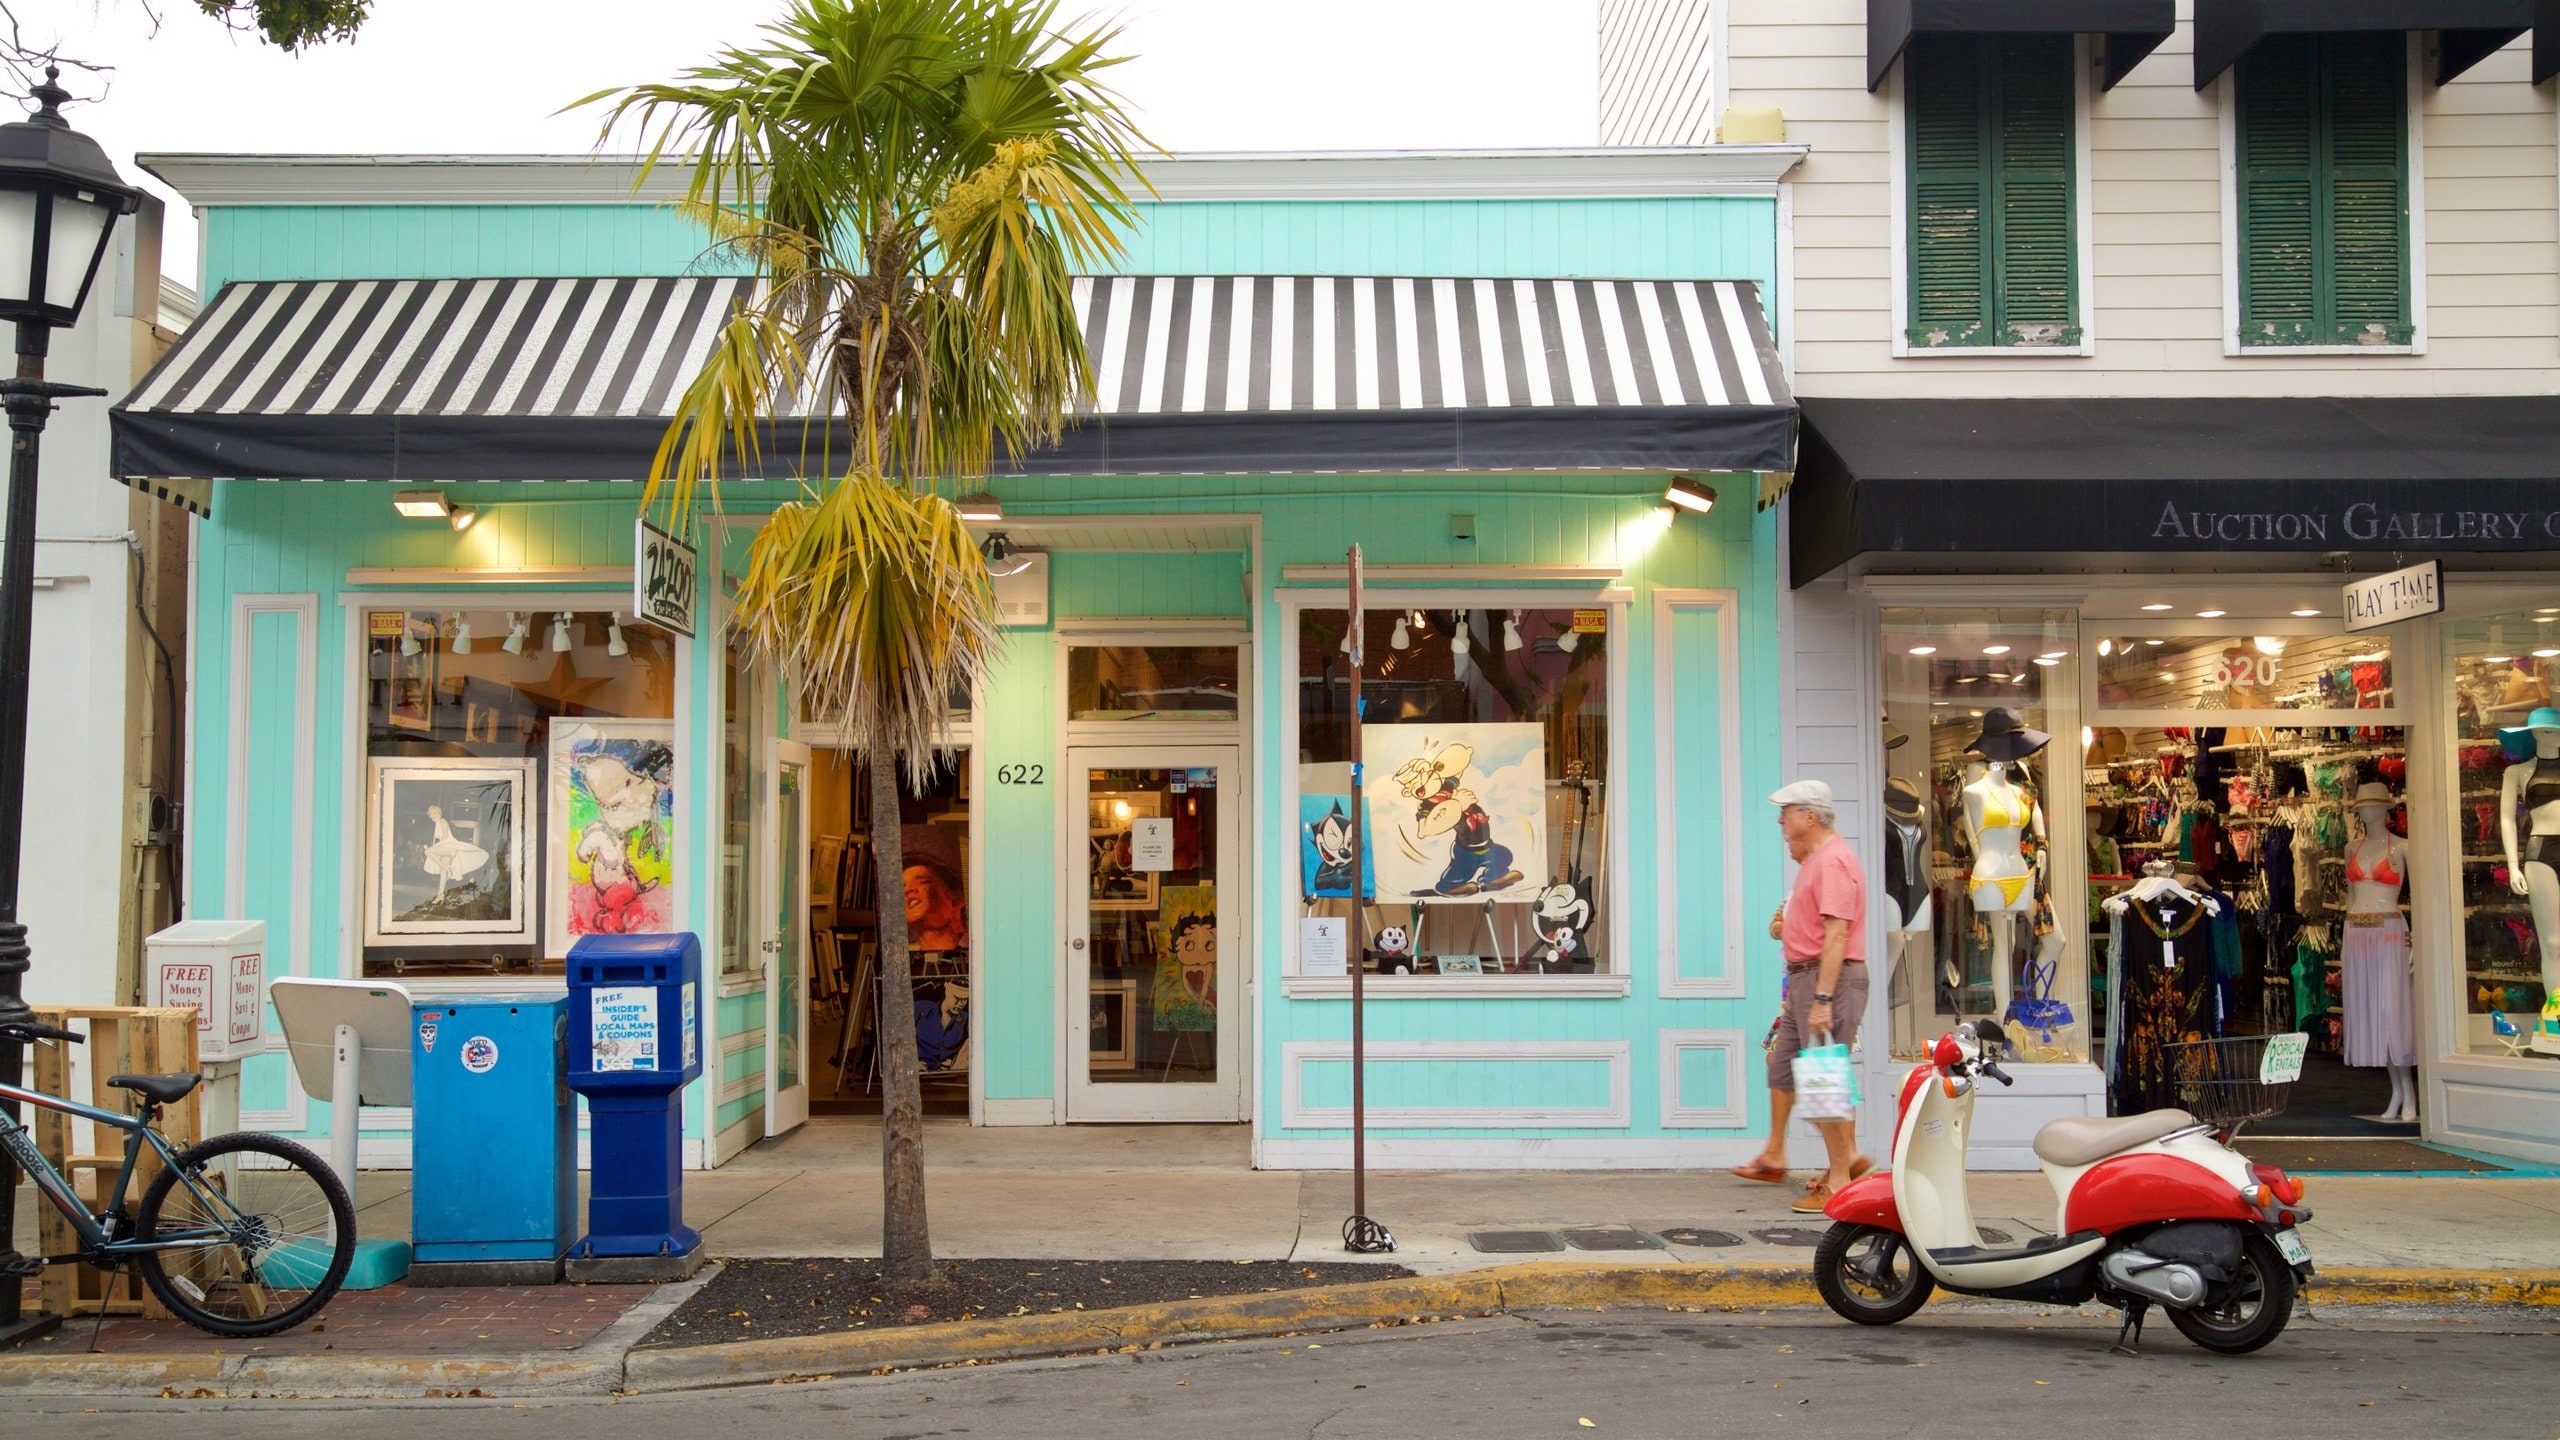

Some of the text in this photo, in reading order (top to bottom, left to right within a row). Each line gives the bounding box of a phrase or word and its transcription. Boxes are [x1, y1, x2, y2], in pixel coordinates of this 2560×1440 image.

[2151, 500, 2327, 541] AUCTION
[2343, 502, 2529, 541] GALLERY
[646, 540, 692, 611] ZAZOO
[2346, 573, 2433, 623] PLAY TIME
[2212, 655, 2276, 686] 620
[998, 764, 1043, 784] 622
[165, 968, 208, 981] FREE
[234, 958, 258, 977] REE
[169, 984, 203, 998] Money
[595, 992, 623, 1004] FREE
[602, 1005, 647, 1013] INSIDER'S
[595, 1022, 655, 1031] LOCAL MAPS
[607, 1031, 652, 1039] COUPONS
